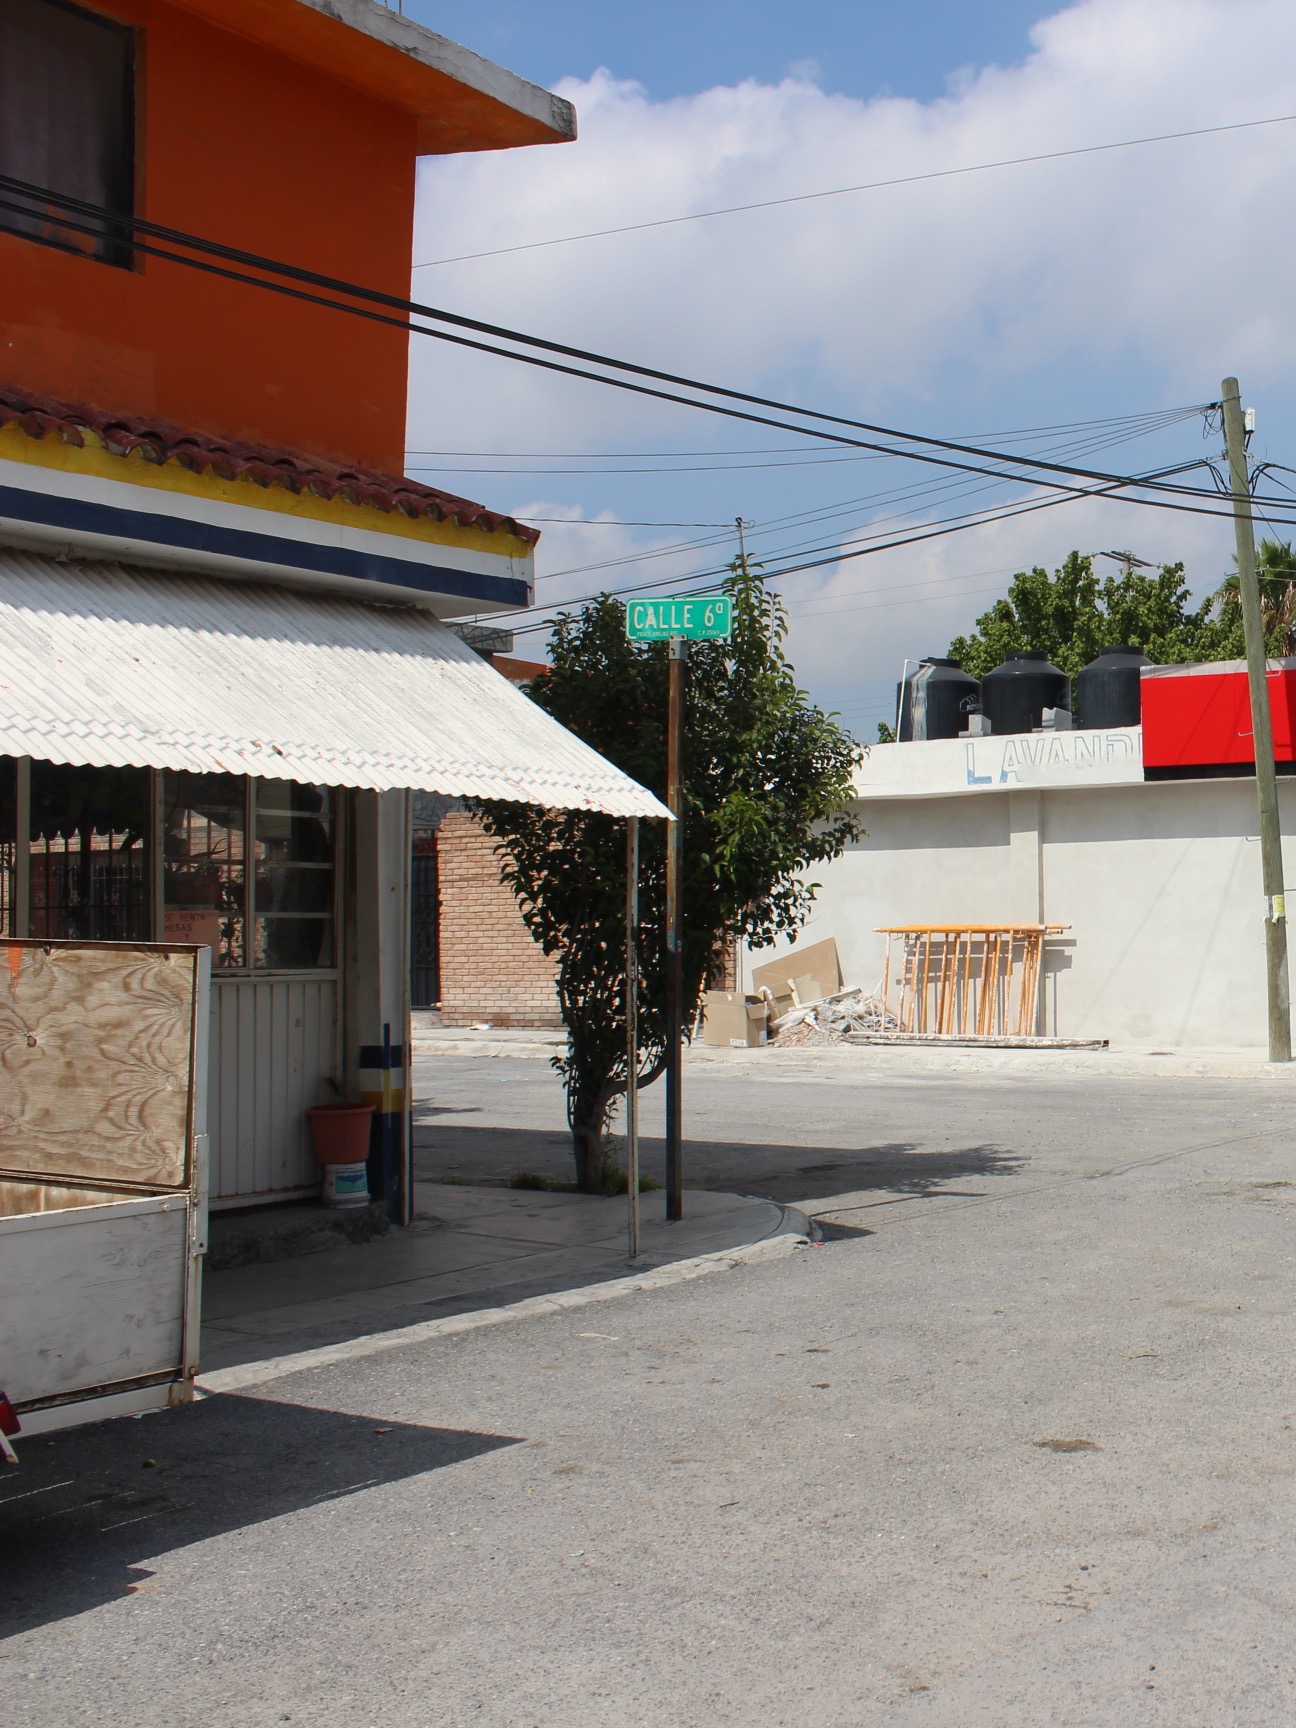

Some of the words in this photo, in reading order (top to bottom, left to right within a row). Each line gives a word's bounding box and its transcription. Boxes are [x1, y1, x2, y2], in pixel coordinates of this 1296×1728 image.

[633, 604, 694, 629] CALLE
[966, 733, 1143, 786] LAVAND
[165, 923, 193, 933] MESAS
